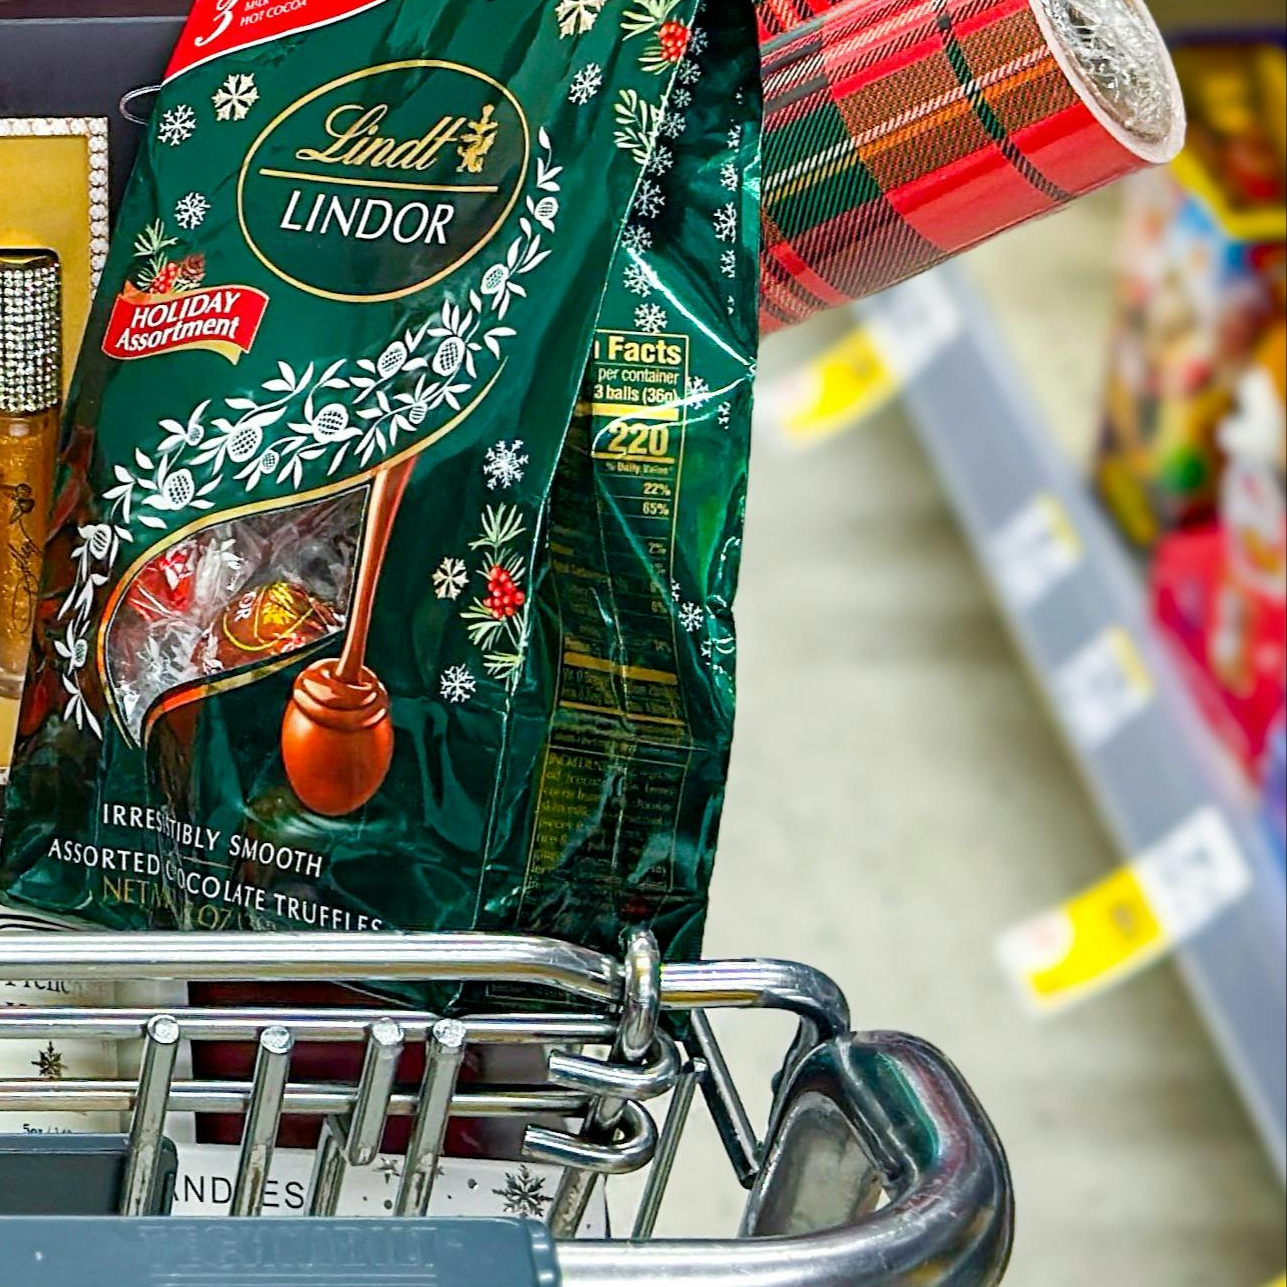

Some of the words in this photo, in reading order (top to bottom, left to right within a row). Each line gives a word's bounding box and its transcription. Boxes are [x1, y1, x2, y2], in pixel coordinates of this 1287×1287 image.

[240, 11, 264, 27] HOT
[296, 104, 458, 171] Lindt
[280, 190, 454, 245] LINDOR
[130, 291, 241, 329] HOLIDAY
[115, 316, 240, 352] Assortment
[608, 335, 682, 365] Facts
[598, 368, 620, 382] per
[621, 368, 680, 385] container
[606, 385, 639, 402] balls
[608, 422, 669, 457] 220
[48, 838, 160, 876] ASSORTED
[229, 834, 323, 878] SMOOTH
[103, 876, 148, 905] NET
